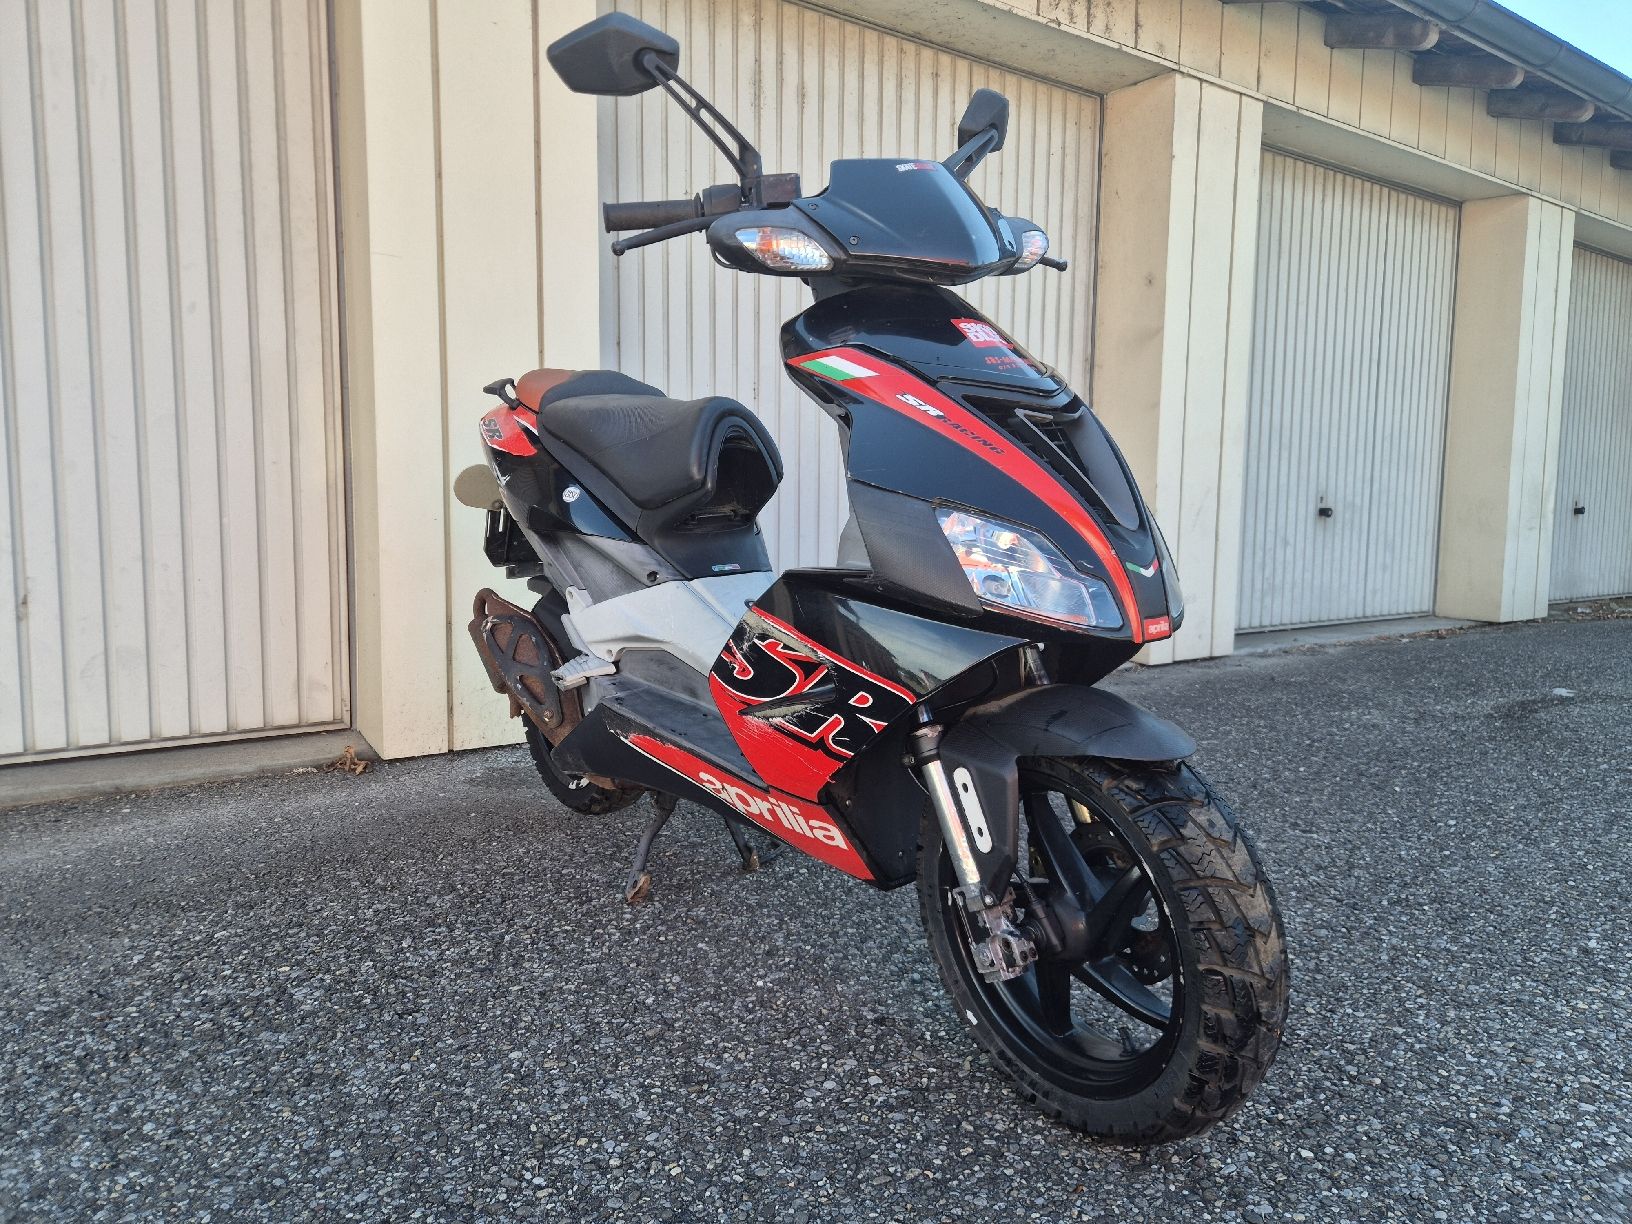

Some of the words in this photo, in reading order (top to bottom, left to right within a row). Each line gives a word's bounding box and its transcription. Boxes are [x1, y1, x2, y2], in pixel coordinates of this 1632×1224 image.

[1148, 620, 1169, 634] aprilia
[710, 620, 894, 758] SR
[698, 771, 849, 850] aprilia
